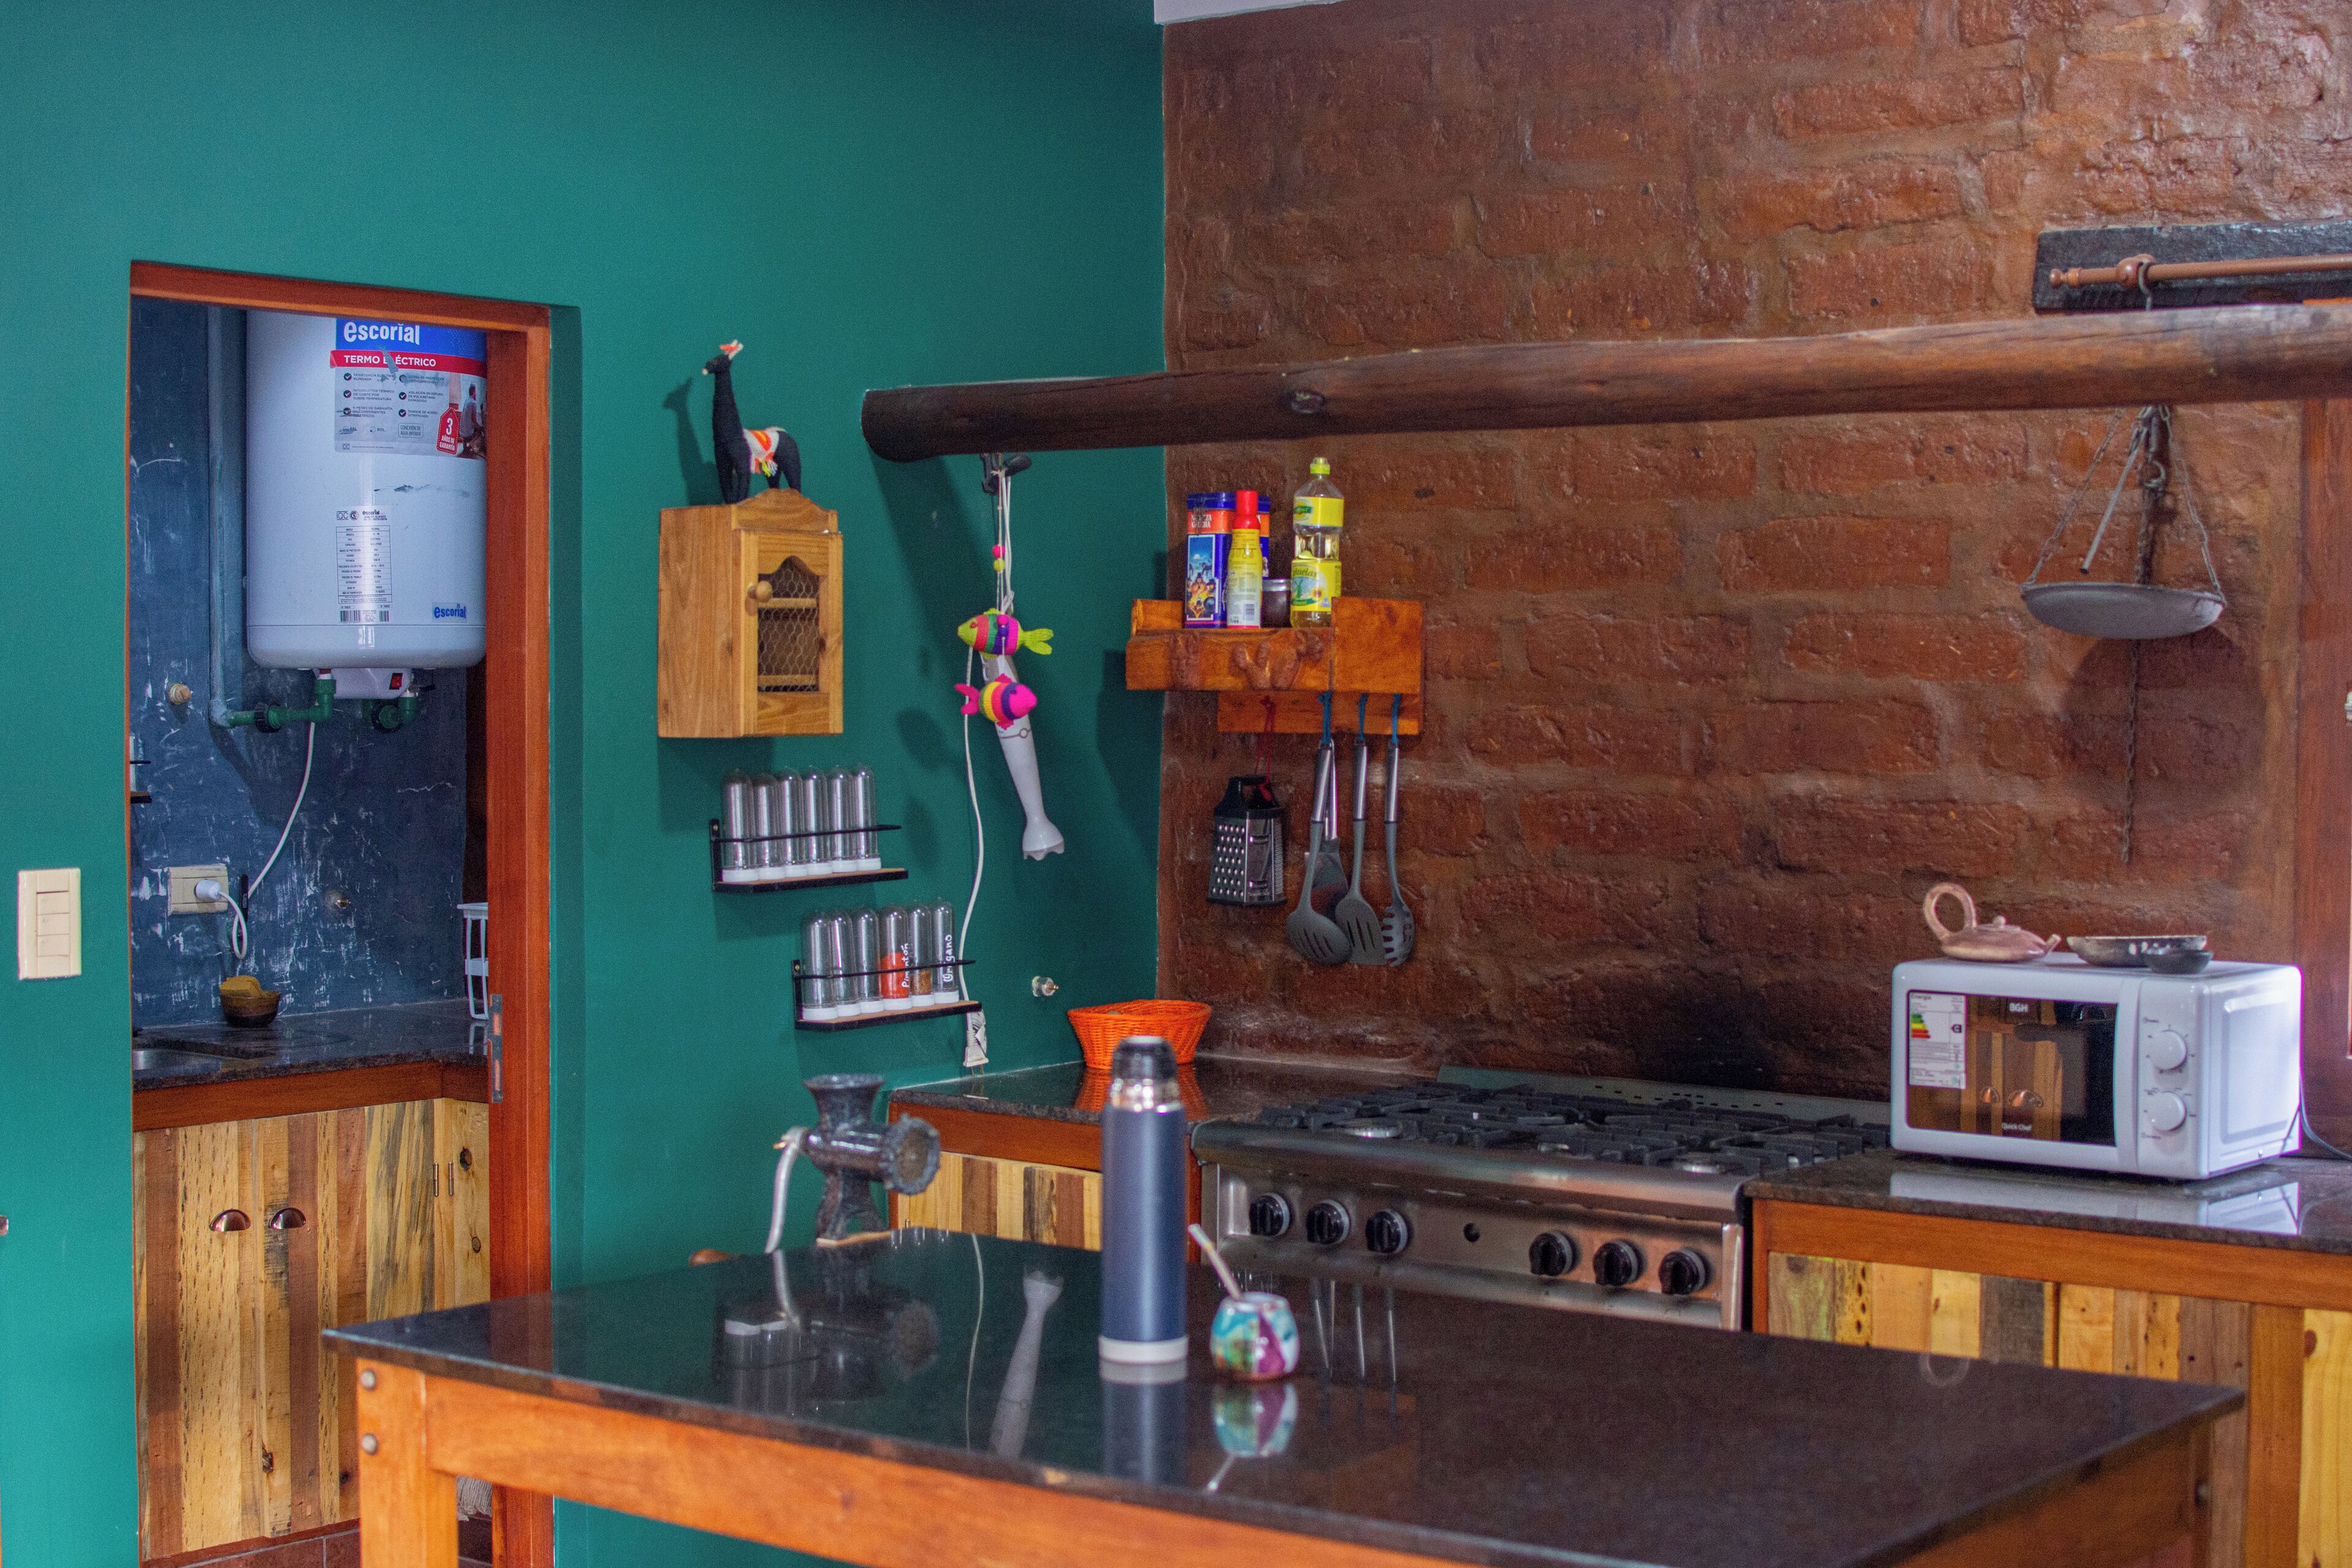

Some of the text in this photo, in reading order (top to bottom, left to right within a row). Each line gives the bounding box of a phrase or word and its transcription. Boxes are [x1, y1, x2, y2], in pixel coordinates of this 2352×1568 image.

[344, 322, 420, 345] escorial
[344, 355, 437, 367] TERMO EÉCTRICO
[446, 417, 453, 435] 3
[434, 604, 466, 619] escorial
[901, 943, 910, 988] Pimntón
[943, 934, 956, 982] Organo
